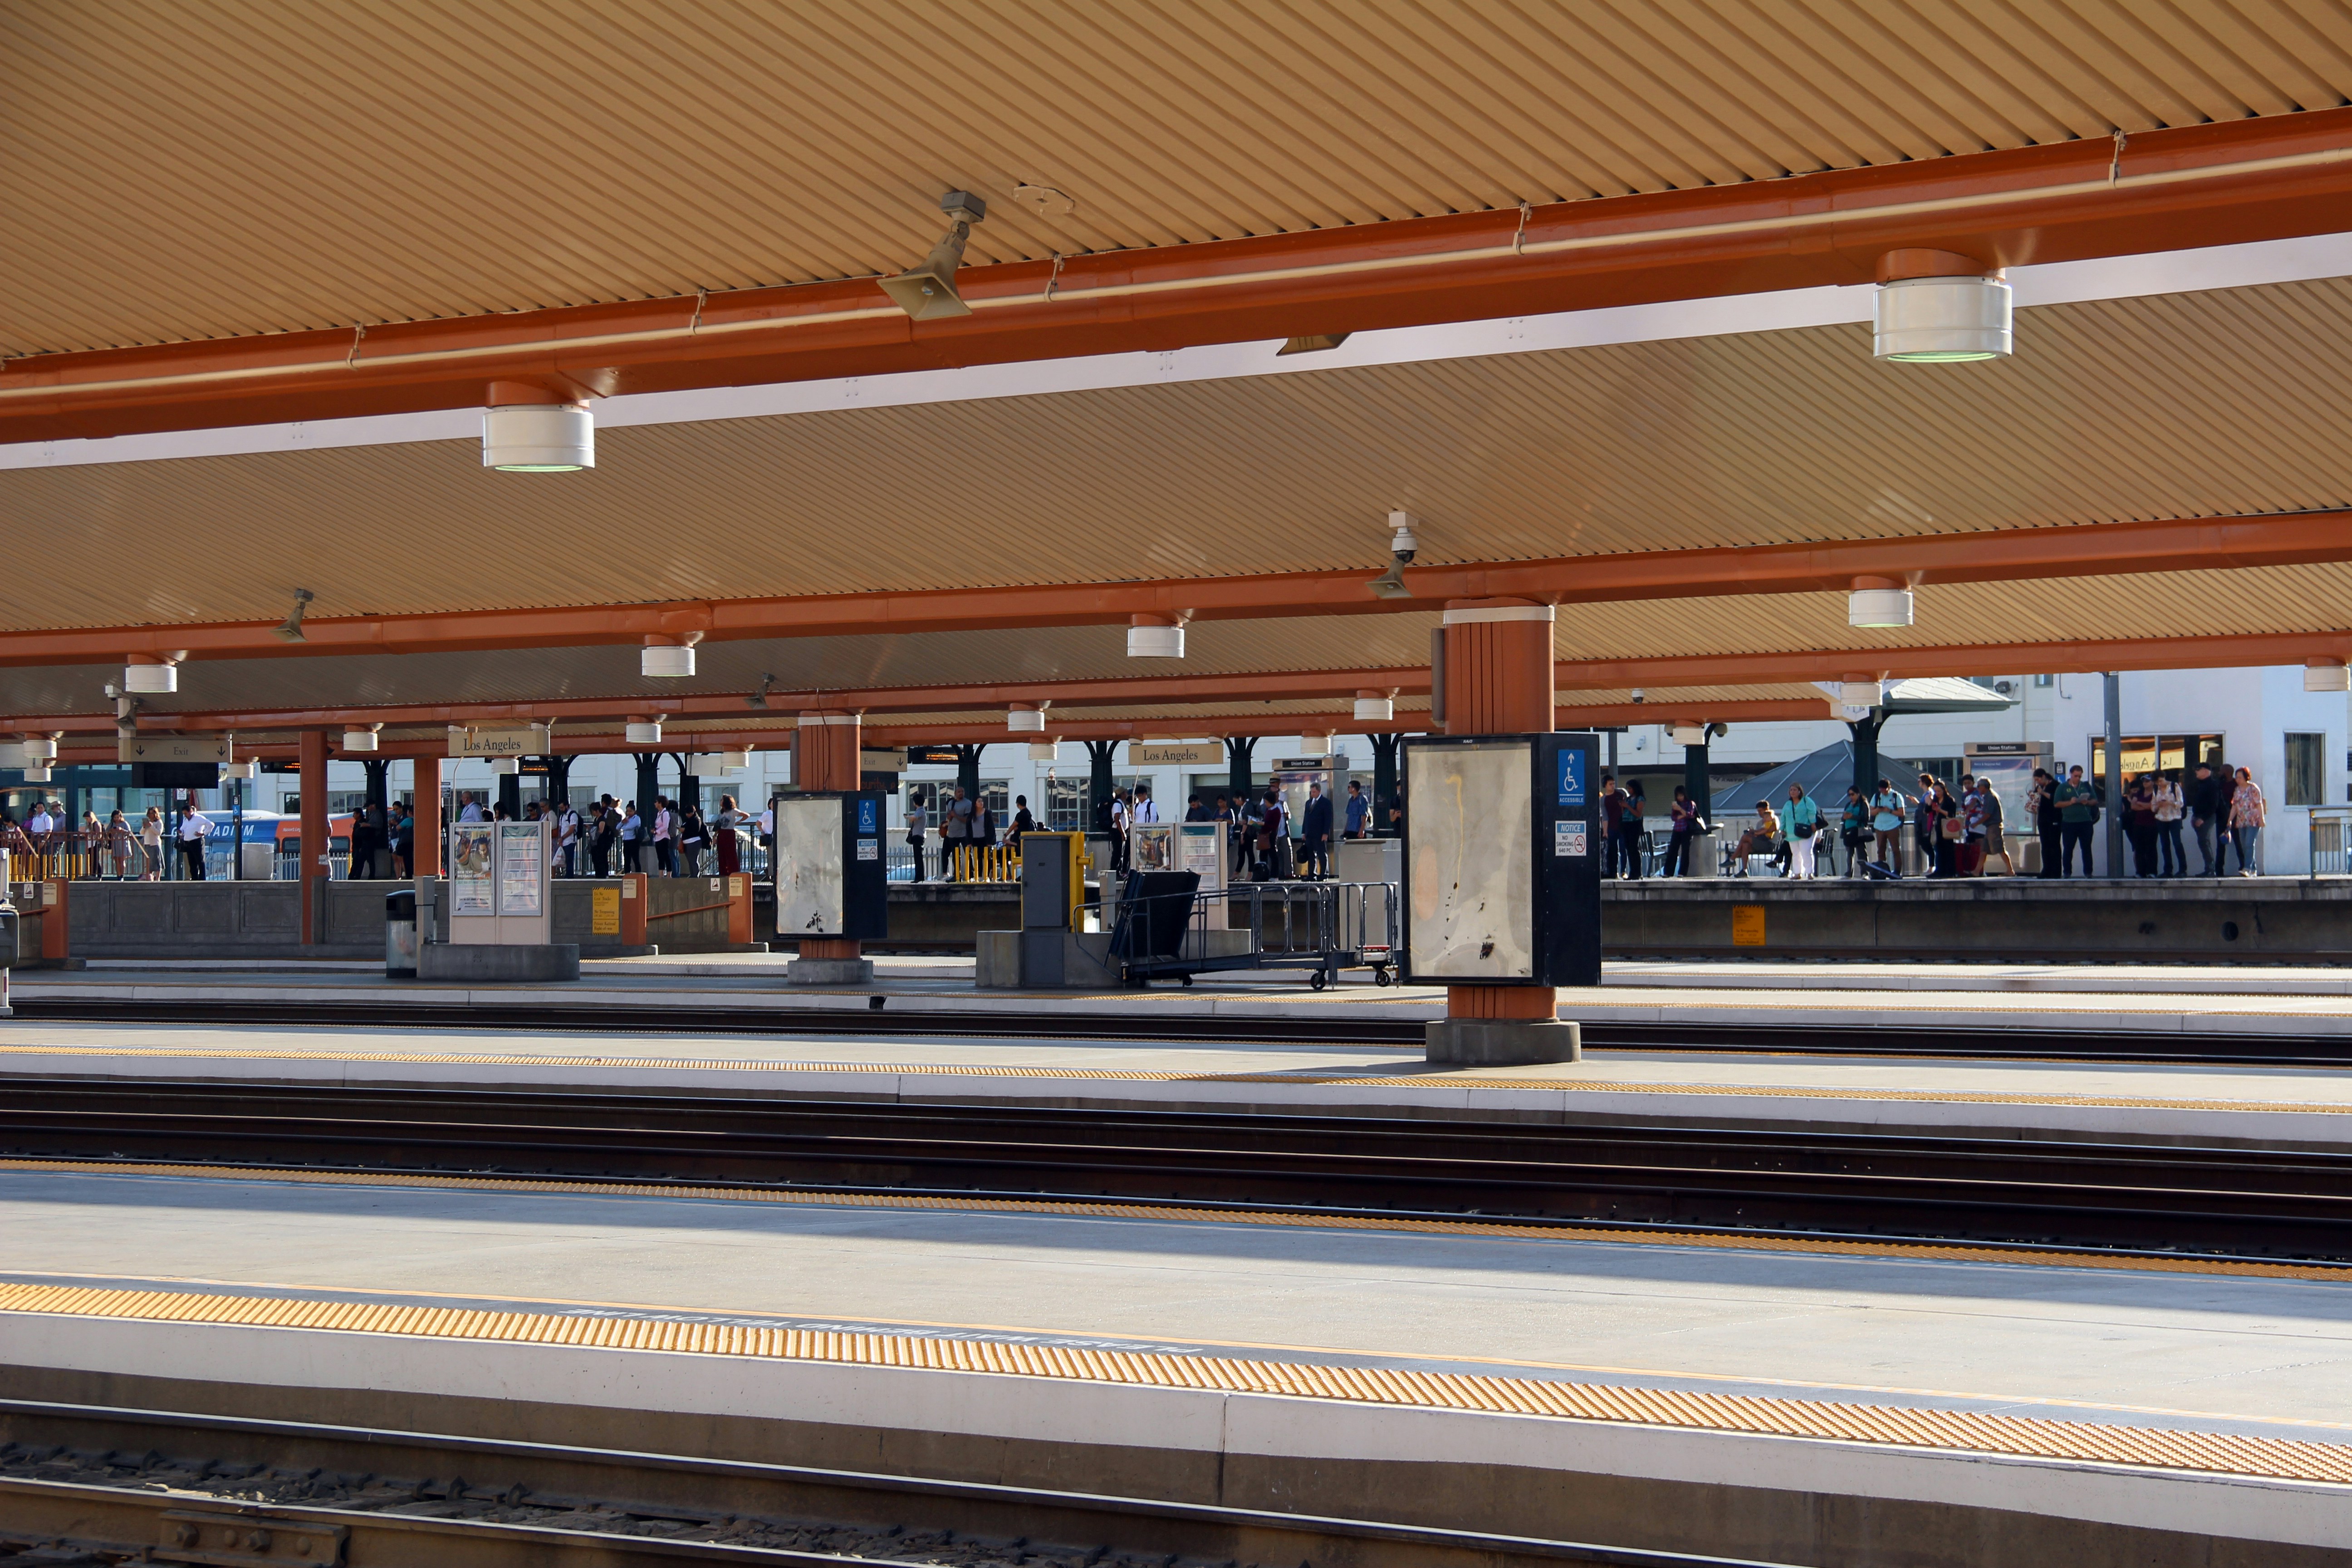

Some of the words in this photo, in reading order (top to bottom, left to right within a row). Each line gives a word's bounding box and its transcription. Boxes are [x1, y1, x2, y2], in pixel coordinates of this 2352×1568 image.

[173, 747, 188, 755] Exit
[464, 738, 480, 751] Los
[483, 737, 520, 753] Angeles
[1143, 750, 1159, 761] Los
[1162, 749, 1198, 762] Angeles
[558, 1308, 647, 1317] LINE
[642, 1314, 790, 1327] YELLOW
[795, 1323, 941, 1335] BEHIND
[935, 1332, 1039, 1342] WAIT
[1040, 1338, 1203, 1353] PLEASE
